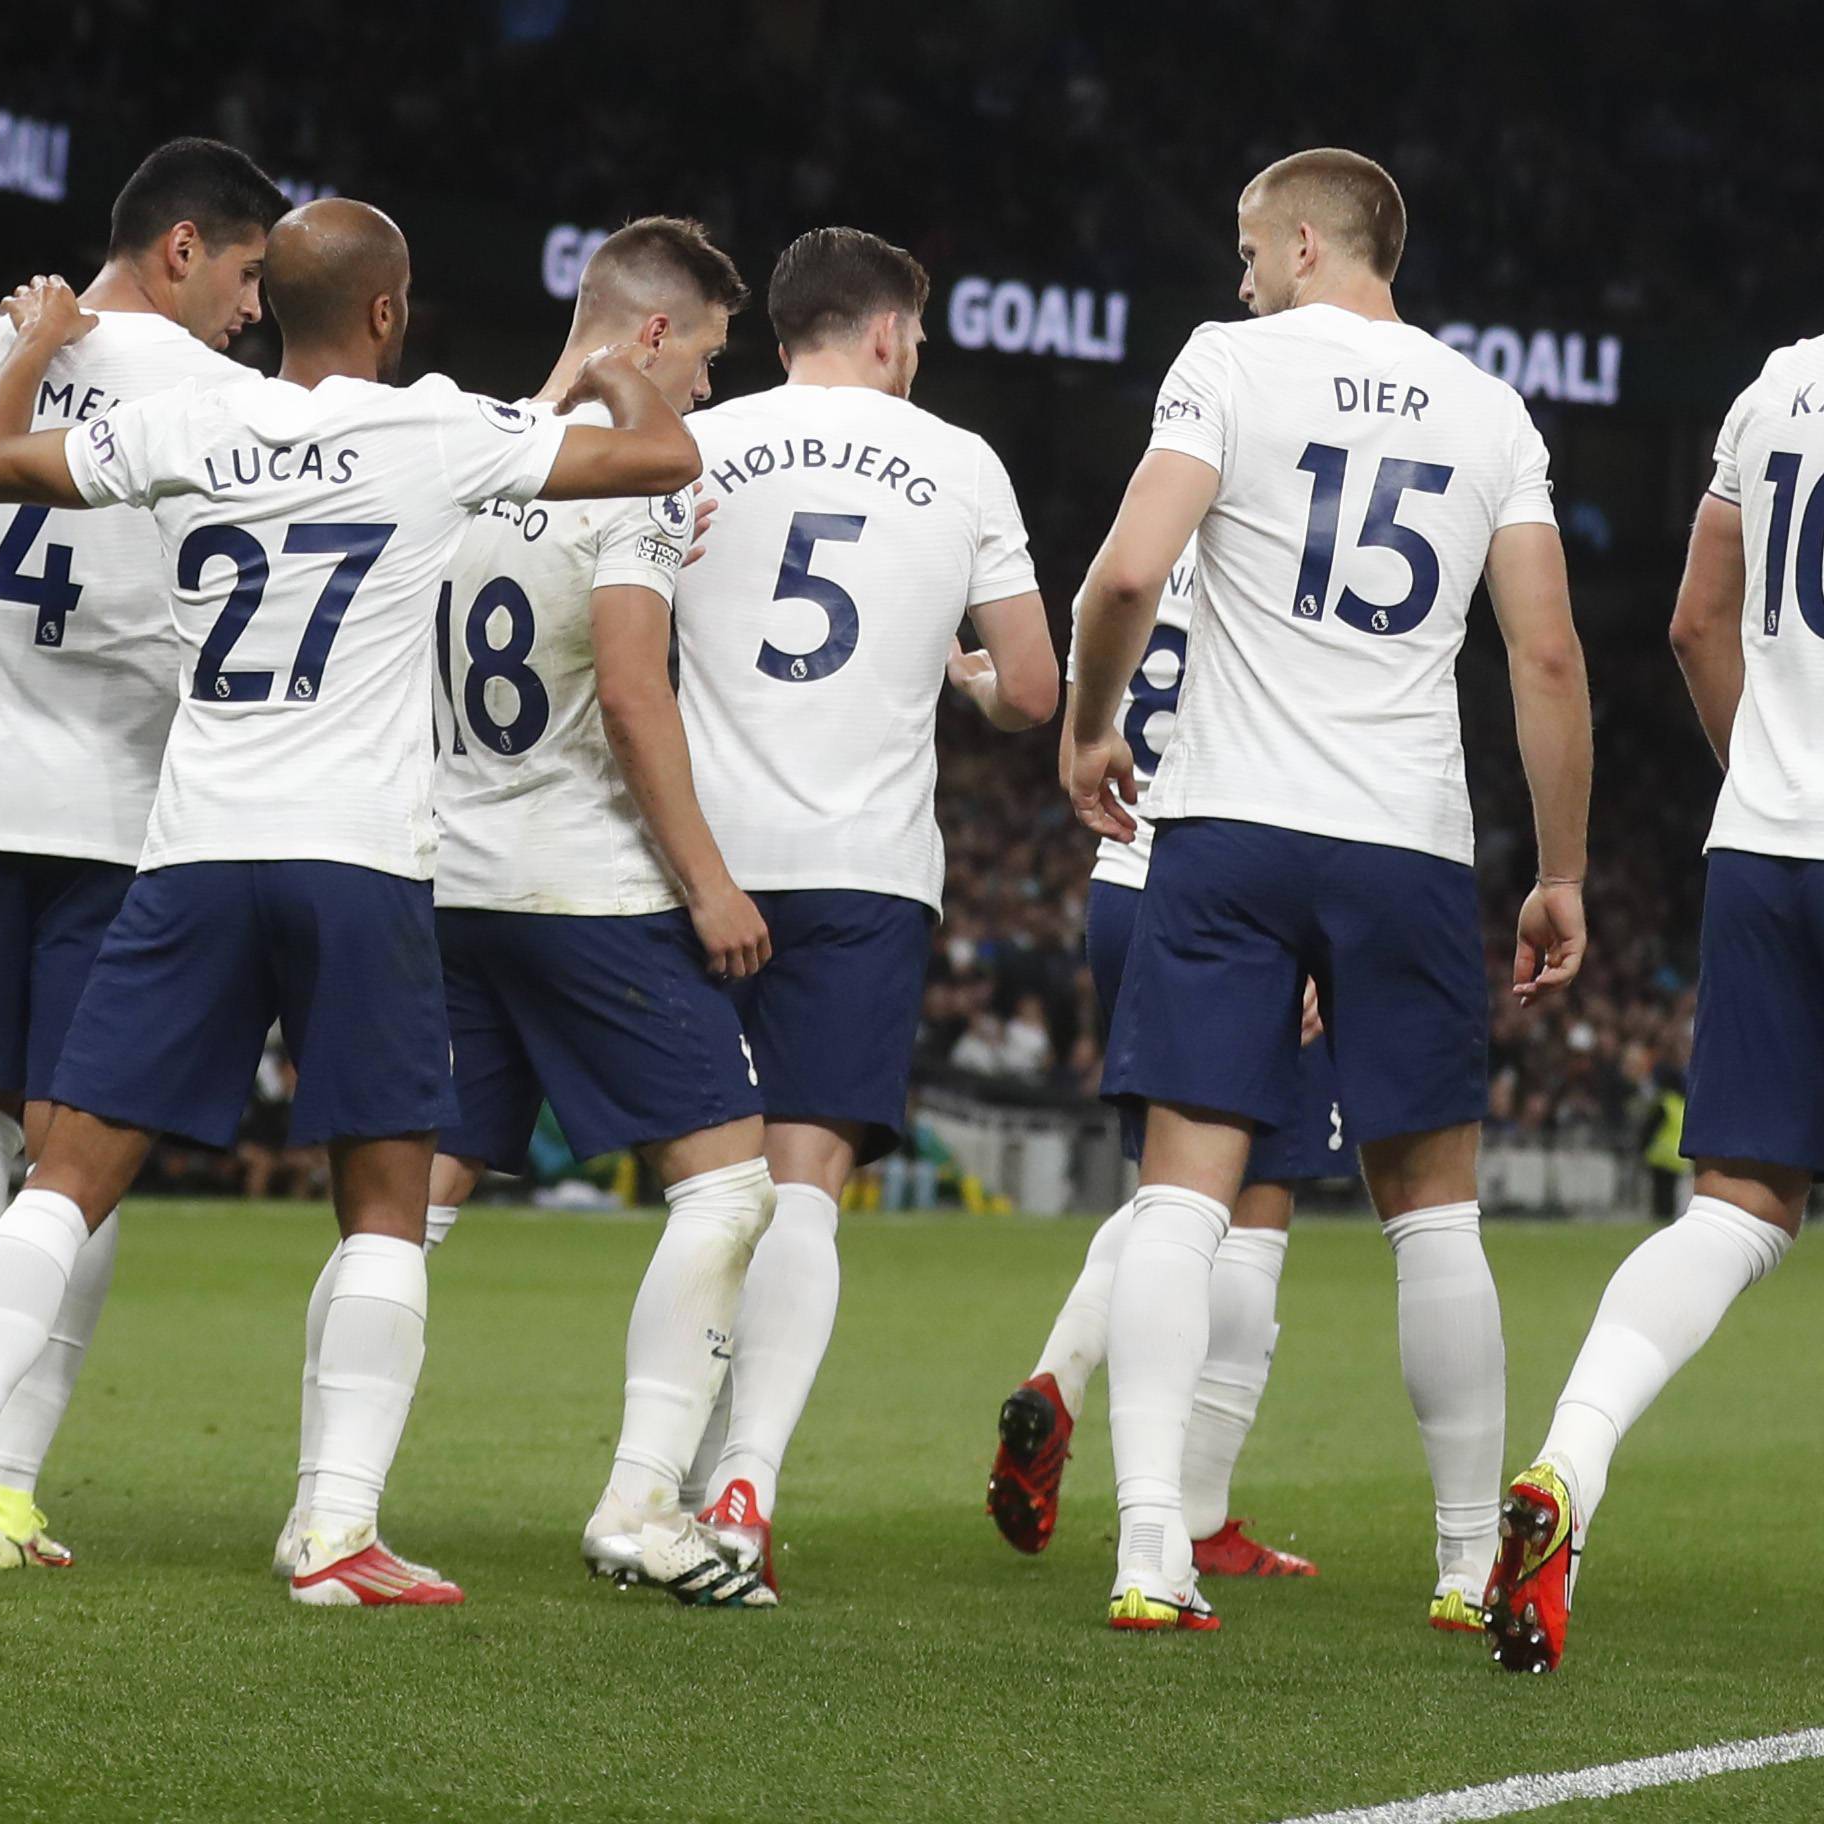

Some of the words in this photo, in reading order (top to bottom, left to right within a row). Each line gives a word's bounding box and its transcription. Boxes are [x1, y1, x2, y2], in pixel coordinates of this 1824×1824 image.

[947, 275, 1129, 363] GOAL!
[37, 380, 121, 423] ME
[1333, 376, 1430, 423] DIER
[205, 443, 360, 492] LUCAS
[710, 437, 939, 508] HØJBJERG
[755, 512, 867, 683] 5
[1291, 441, 1455, 637] 15
[176, 523, 398, 702] 27
[435, 576, 550, 756] 18
[1124, 622, 1188, 776] 8
